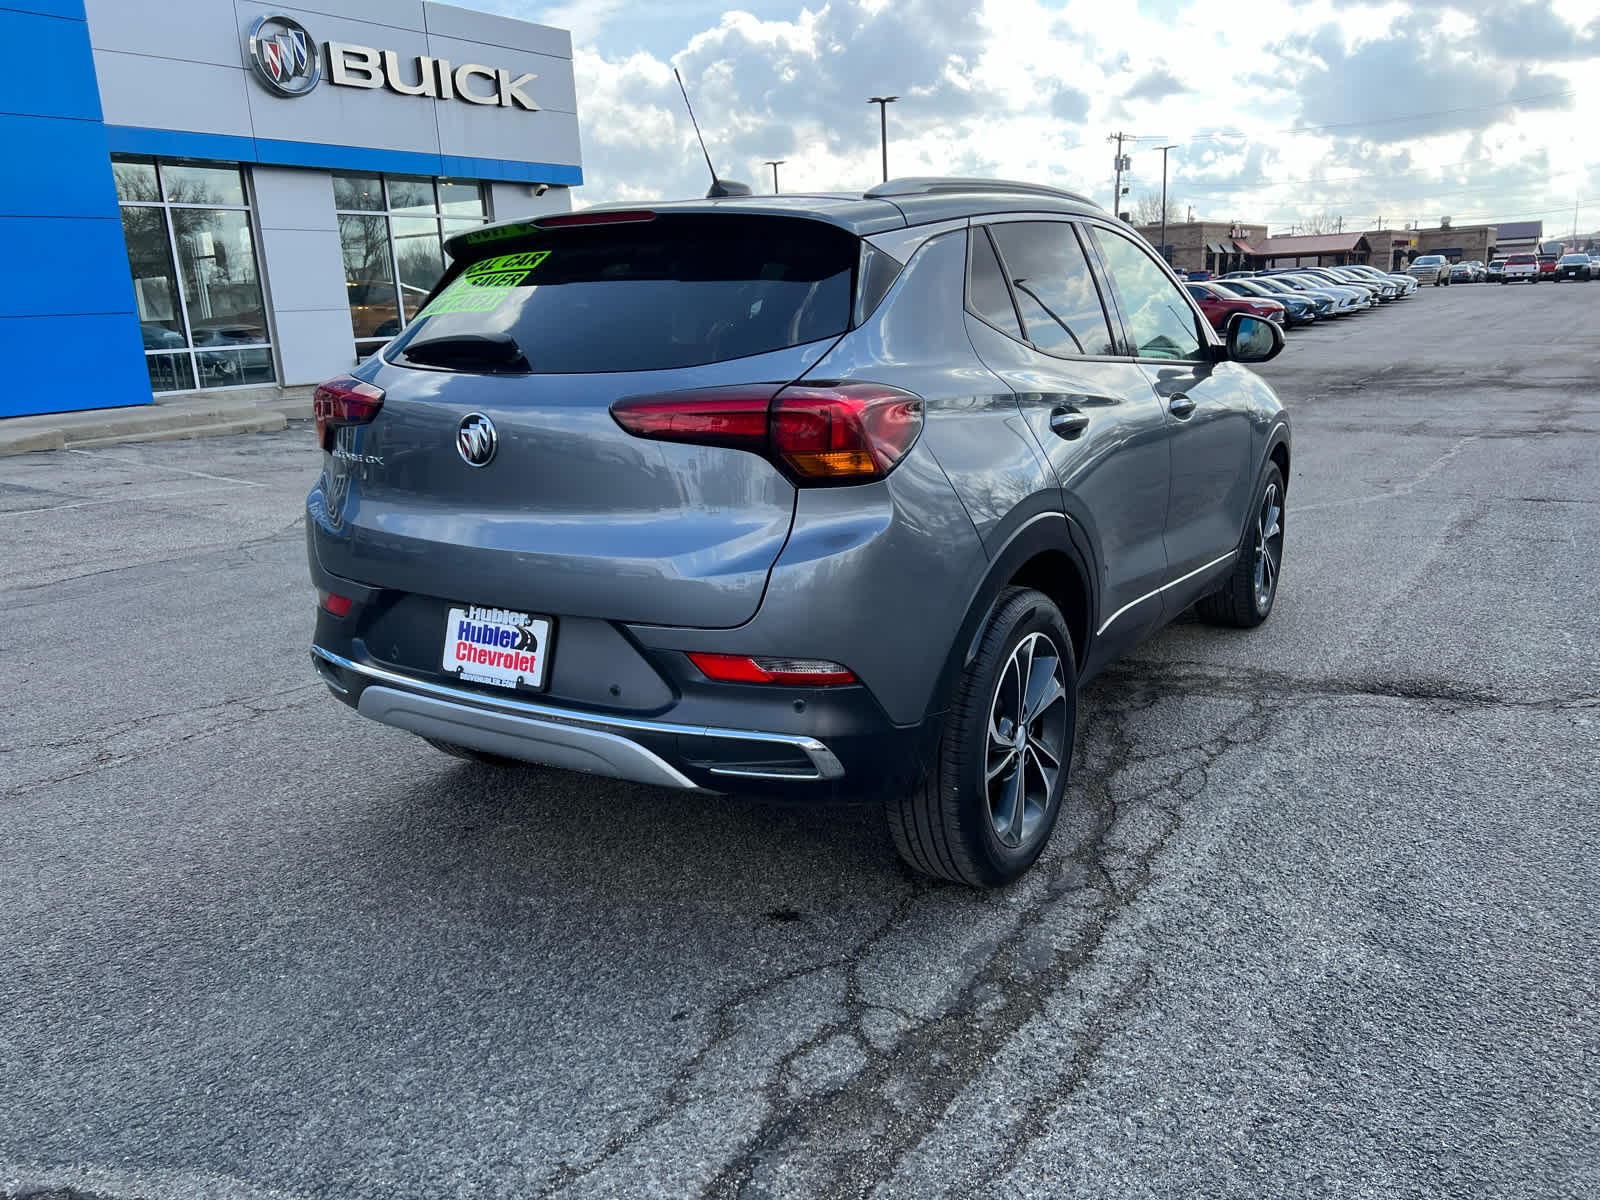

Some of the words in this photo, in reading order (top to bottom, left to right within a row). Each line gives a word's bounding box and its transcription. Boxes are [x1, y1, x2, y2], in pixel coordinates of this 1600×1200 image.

[324, 40, 542, 111] BUICK
[502, 252, 545, 268] CAR
[471, 272, 526, 287] SAVER
[457, 620, 520, 649] Hubler
[455, 641, 537, 674] Chevrolet
